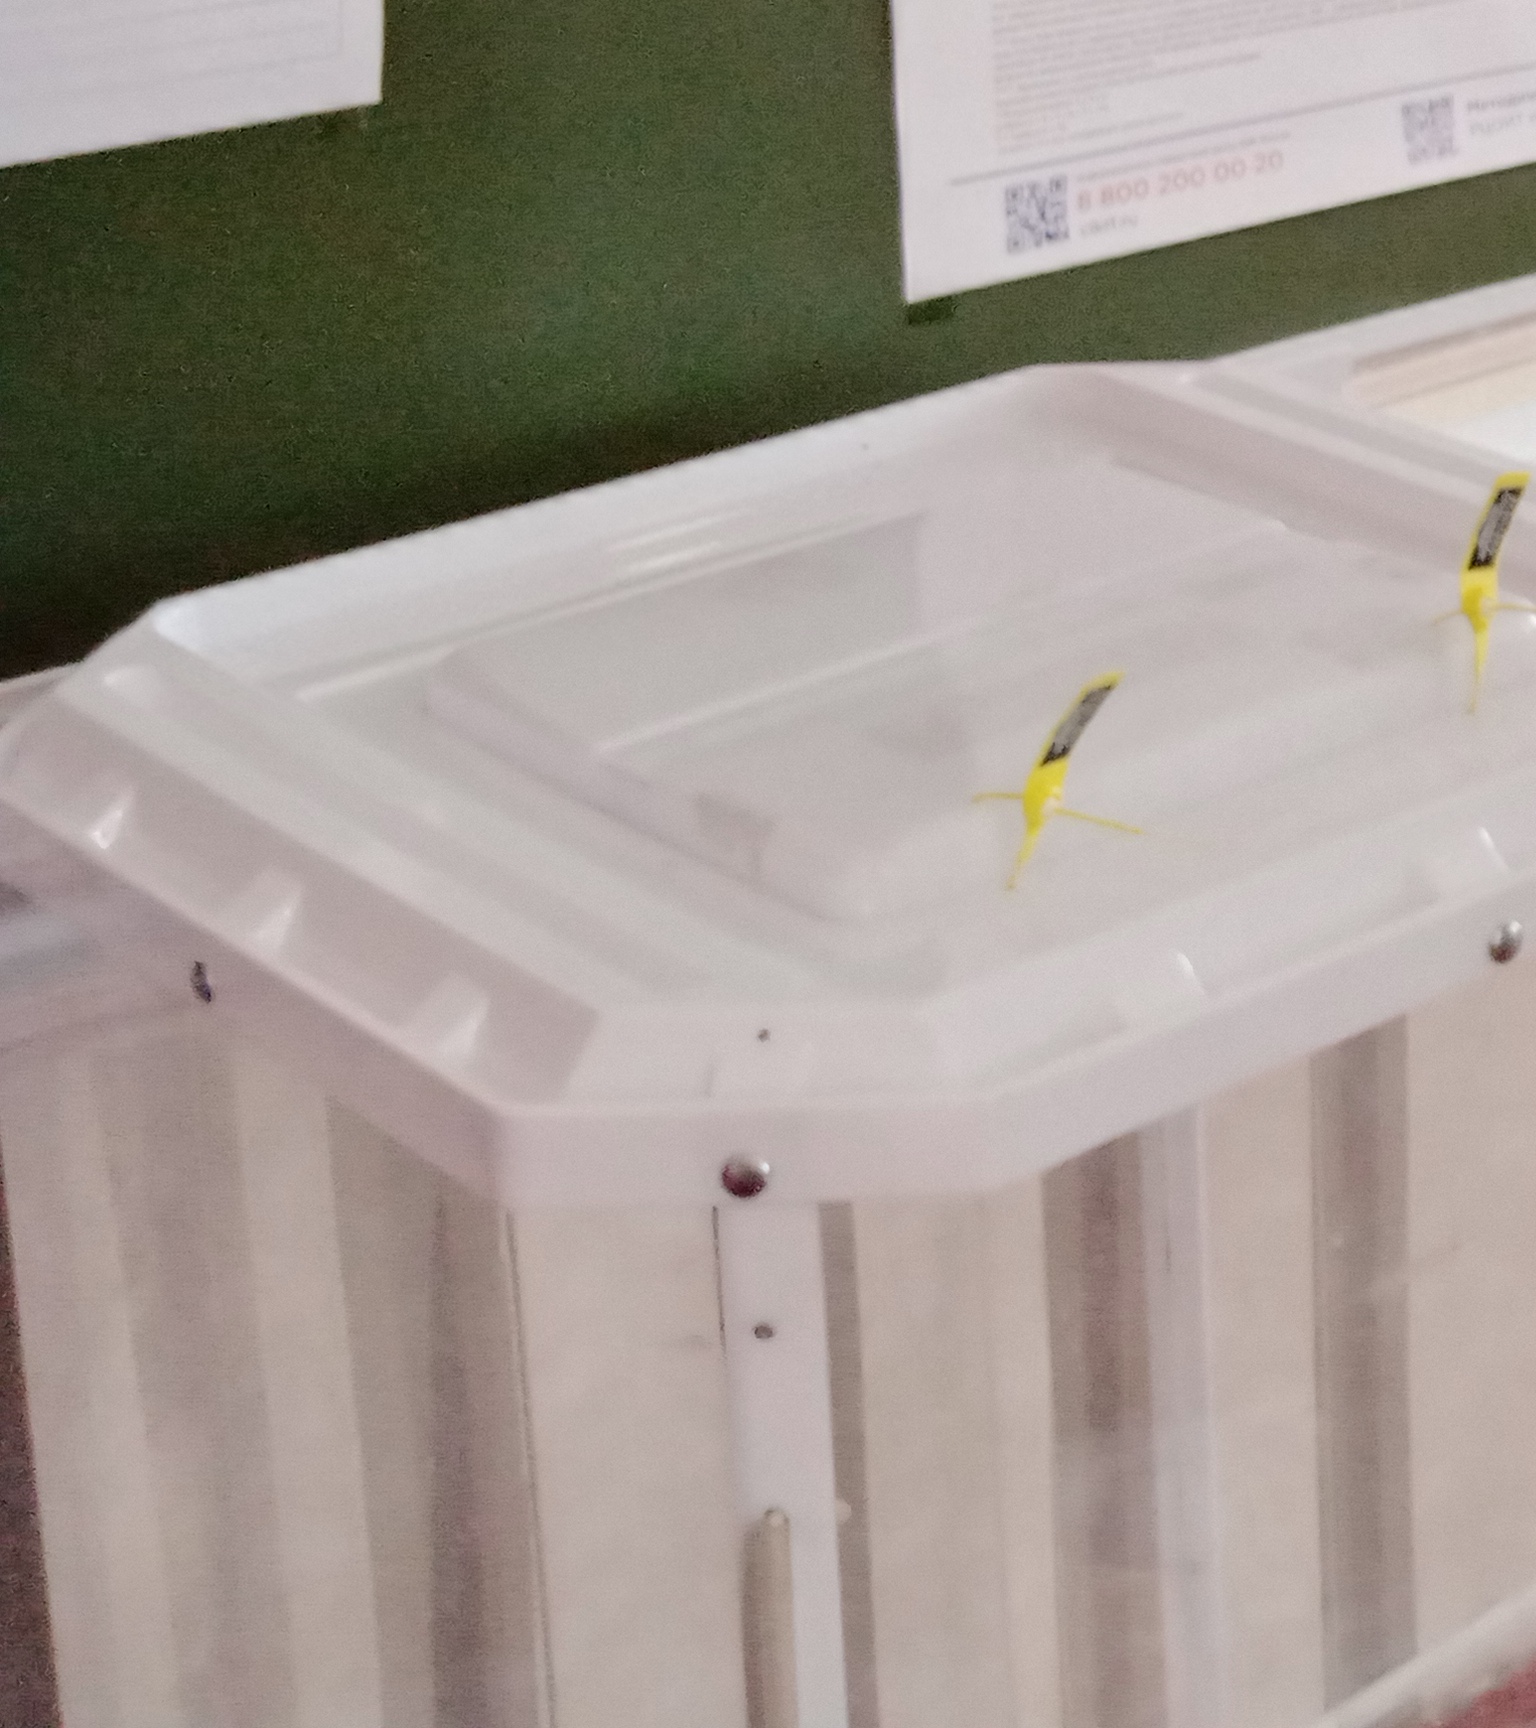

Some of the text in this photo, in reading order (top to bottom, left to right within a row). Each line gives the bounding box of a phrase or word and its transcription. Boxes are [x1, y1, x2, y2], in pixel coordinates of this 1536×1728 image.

[1100, 176, 1149, 205] 800
[1159, 165, 1206, 195] 200
[1214, 156, 1246, 183] 00
